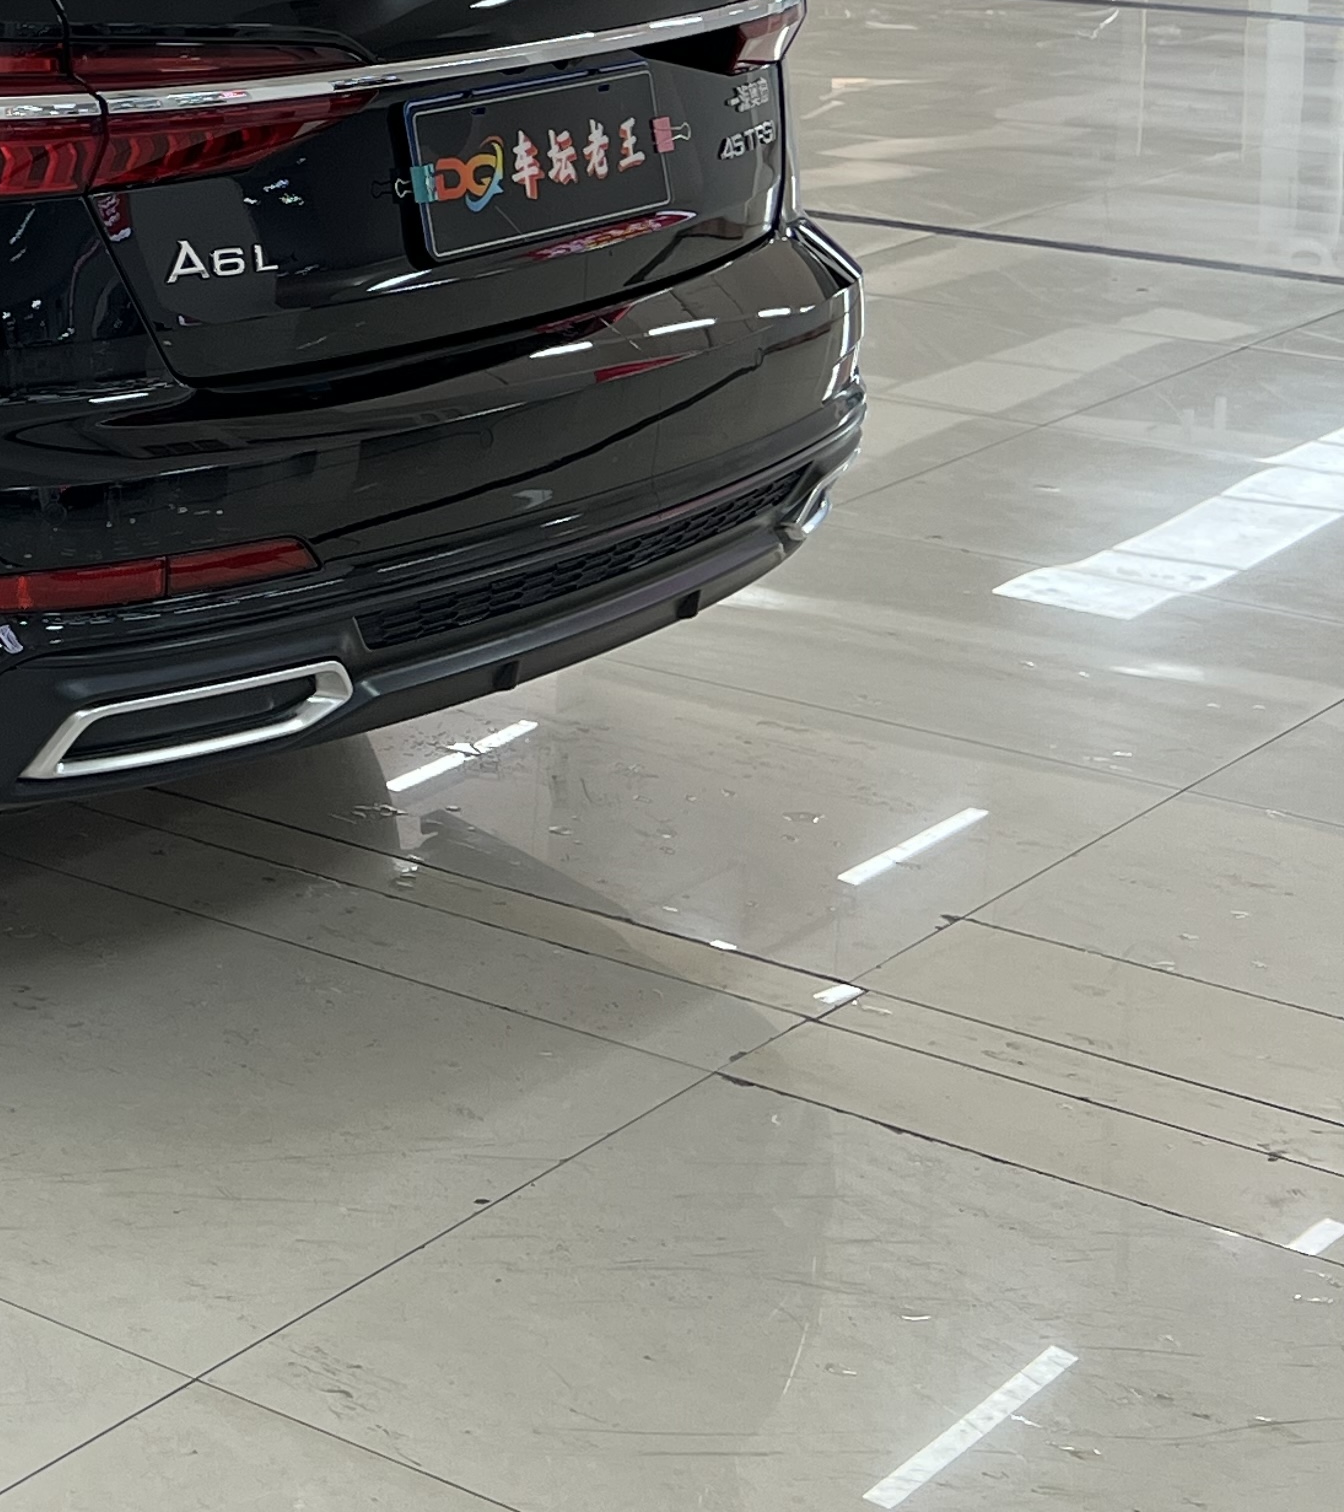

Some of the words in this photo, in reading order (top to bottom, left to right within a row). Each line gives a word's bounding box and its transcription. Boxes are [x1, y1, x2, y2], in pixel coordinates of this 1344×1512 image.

[512, 117, 646, 200] 车坛老王
[166, 240, 279, 284] A6L
